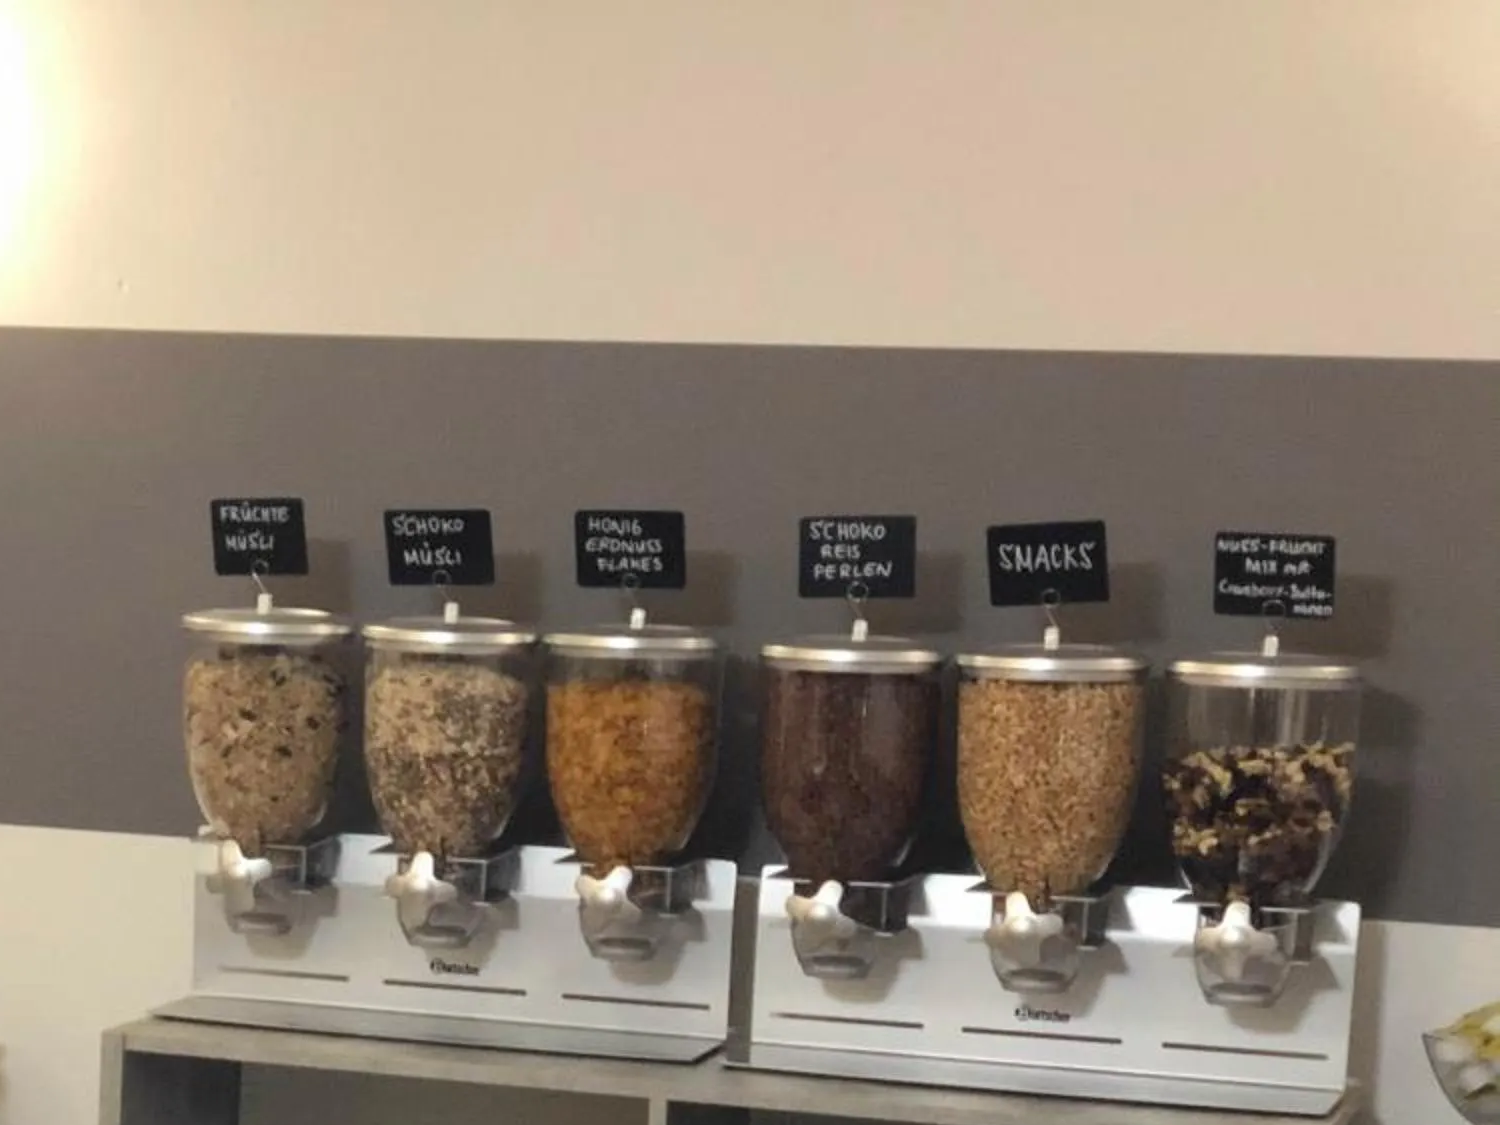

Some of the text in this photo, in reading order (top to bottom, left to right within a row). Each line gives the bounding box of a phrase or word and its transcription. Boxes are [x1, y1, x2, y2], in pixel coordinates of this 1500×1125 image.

[392, 514, 464, 536] SCHOKO
[588, 516, 642, 536] HONIG
[809, 520, 886, 541] SCHOKO
[403, 541, 462, 566] MÜSLI
[820, 544, 861, 559] REIS
[999, 541, 1096, 573] SNACKS
[597, 557, 663, 573] FLAKES
[813, 560, 893, 580] PERLEN
